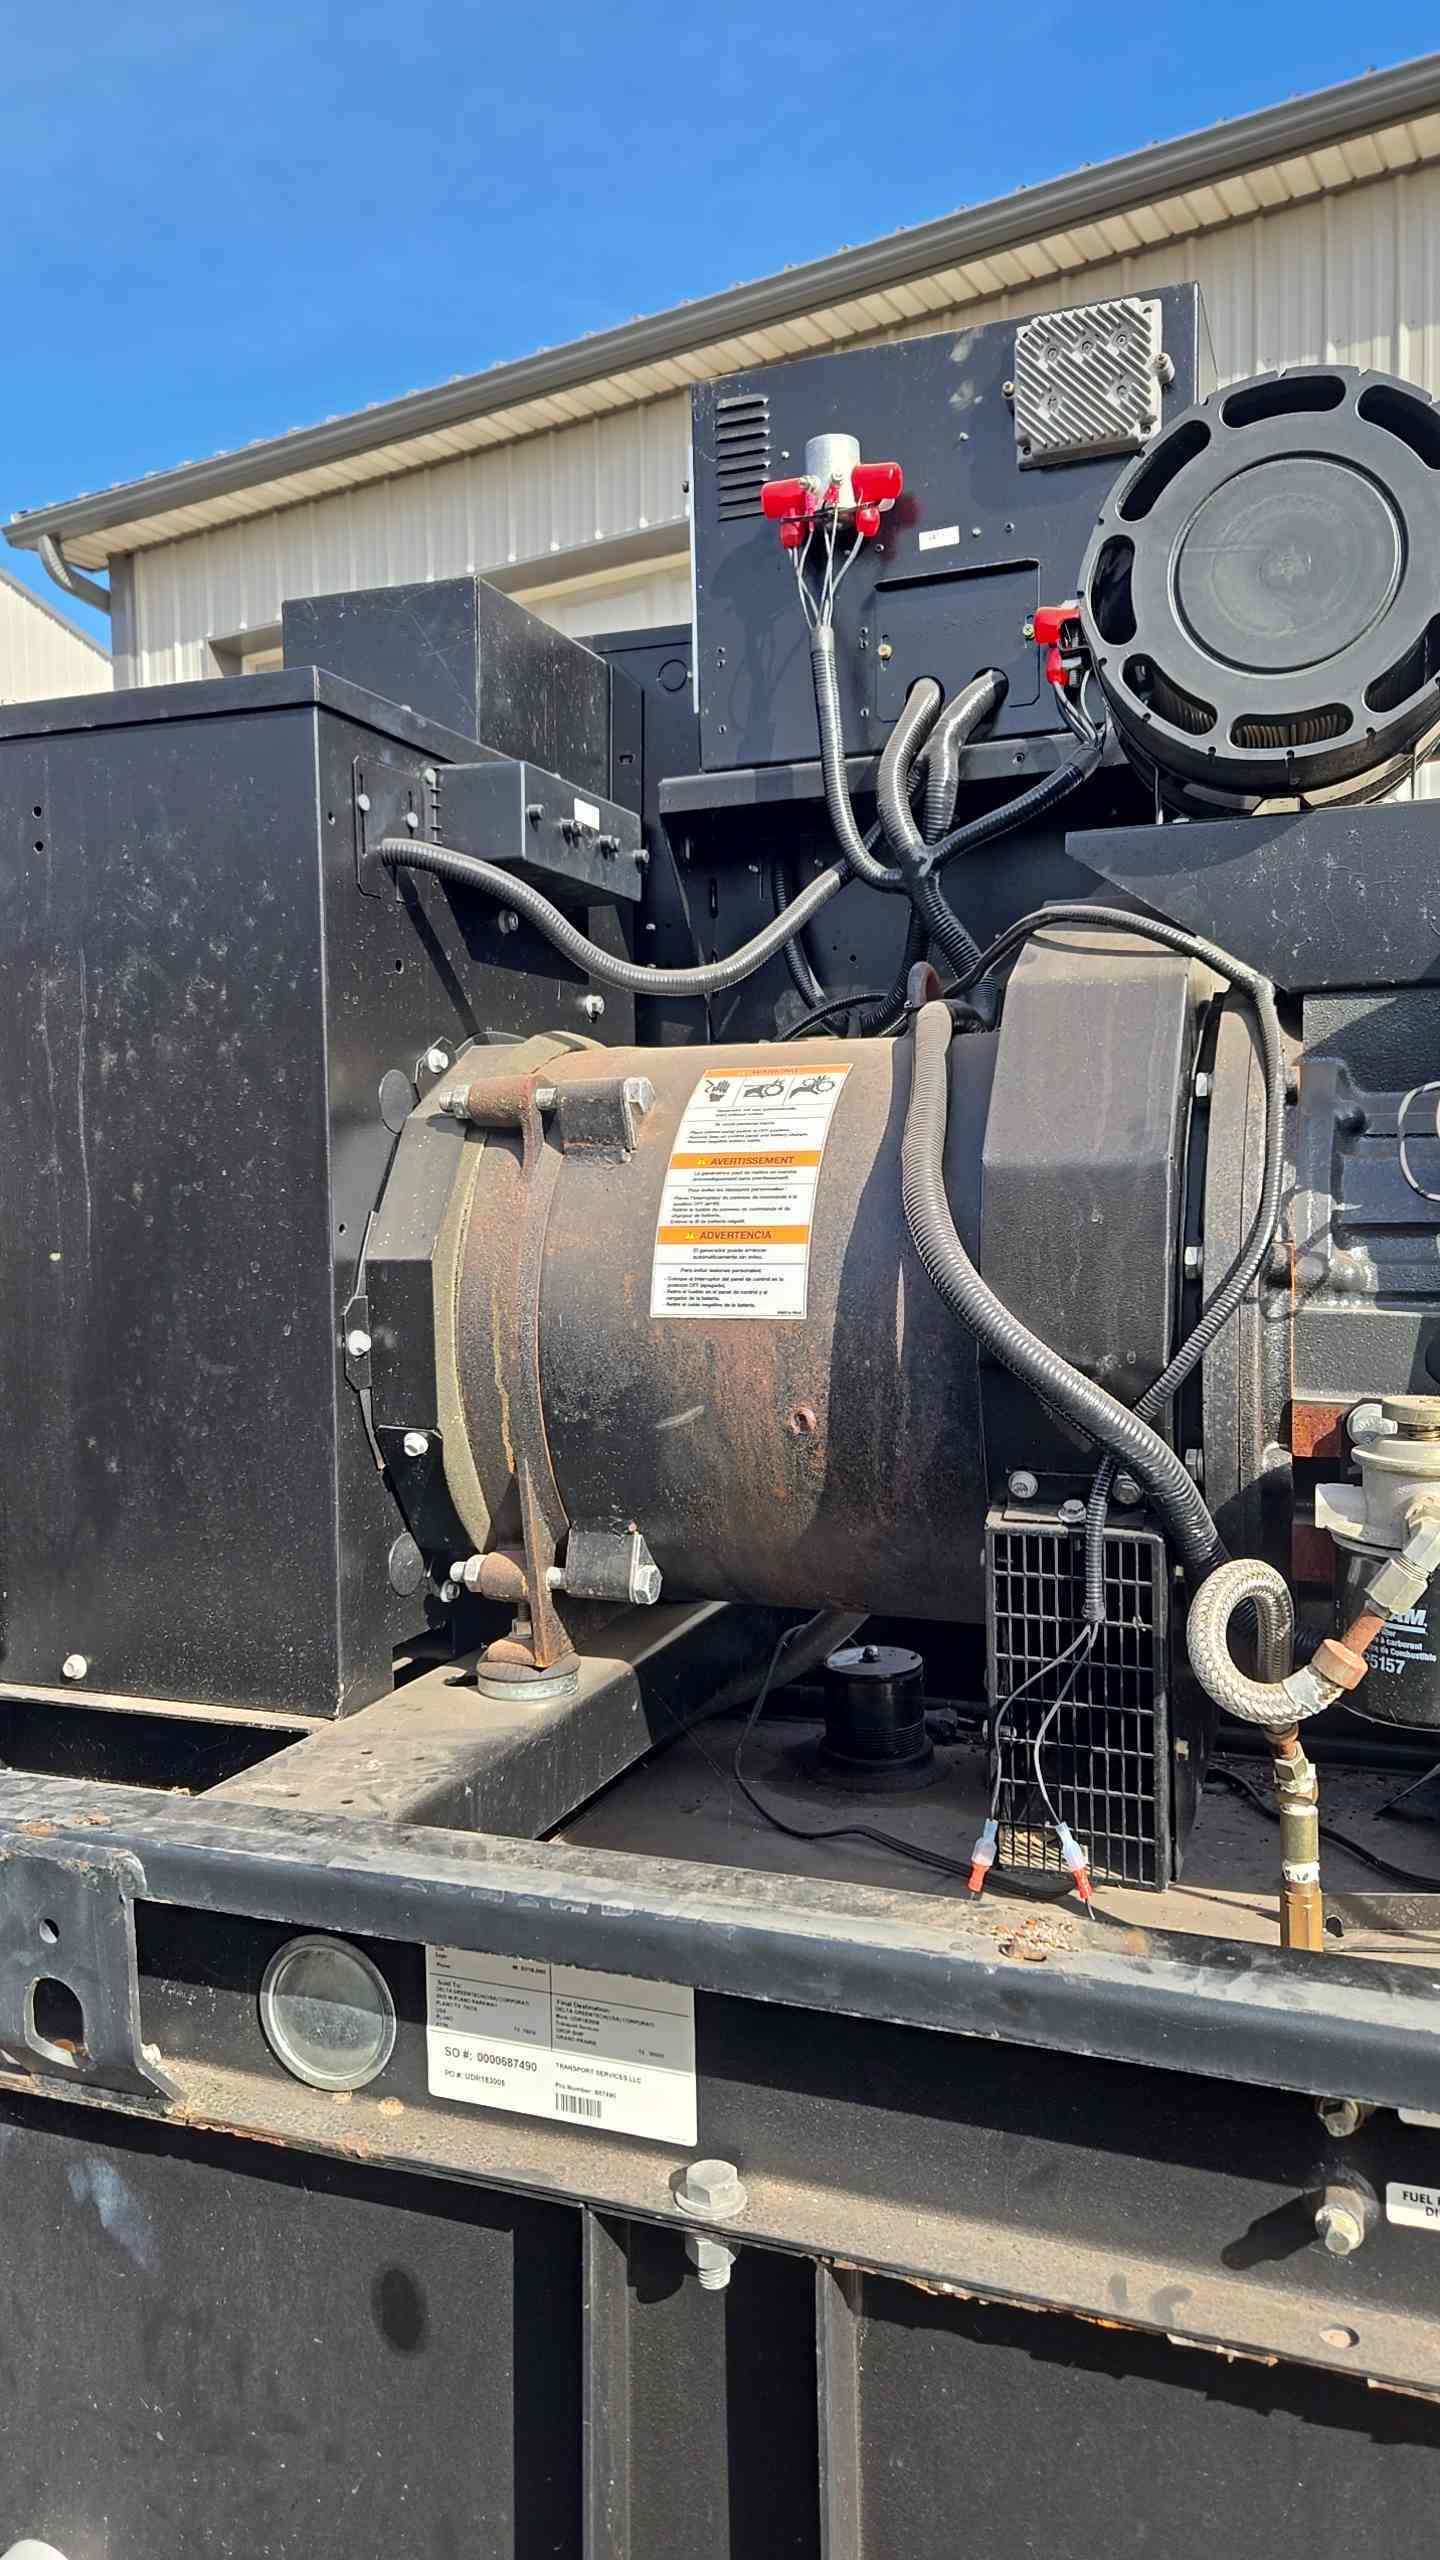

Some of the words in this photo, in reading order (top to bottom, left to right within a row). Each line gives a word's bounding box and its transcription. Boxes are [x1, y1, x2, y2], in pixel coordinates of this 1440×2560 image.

[711, 1157, 795, 1165] AVERTISSEMENT
[700, 1231, 772, 1239] ADVERTENCIA
[1390, 1608, 1427, 1627] AM.
[444, 2046, 460, 2058] SO
[477, 2052, 537, 2072] 0000687490
[555, 2062, 594, 2075] TRANSPORT
[595, 2069, 627, 2082] SERVICES
[628, 2075, 642, 2085] LLC
[1403, 2191, 1432, 2205] FUEL
